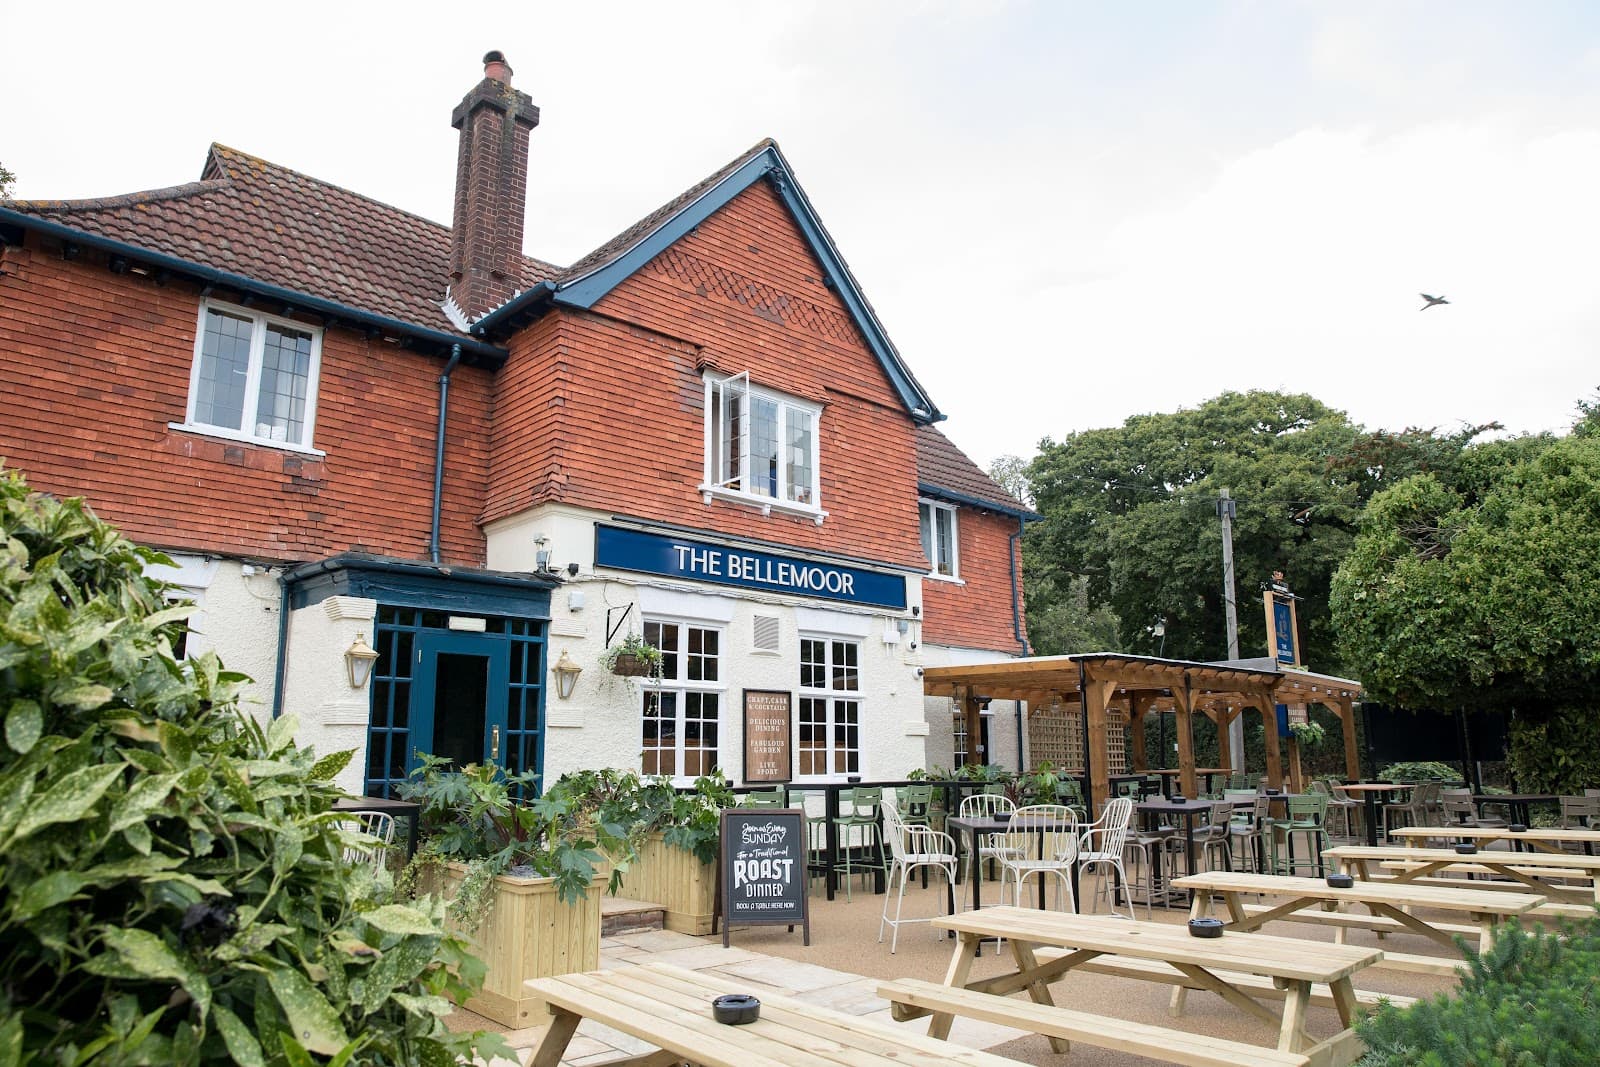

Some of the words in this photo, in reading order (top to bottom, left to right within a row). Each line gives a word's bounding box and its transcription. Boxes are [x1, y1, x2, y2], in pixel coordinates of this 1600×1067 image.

[673, 545, 722, 576] THE
[728, 553, 855, 596] BELLEMOOR
[750, 718, 785, 726] DELICIOUS
[754, 746, 781, 754] GARDEN
[760, 761, 776, 769] LIVE
[766, 821, 786, 836] Every
[742, 832, 784, 844] SUNDAY
[736, 850, 748, 859] For
[753, 845, 789, 858] Traditional
[733, 858, 794, 889] ROAST
[746, 883, 784, 898] DINNER
[736, 902, 749, 910] BOOK
[750, 902, 755, 910] A
[755, 902, 770, 910] TABLE
